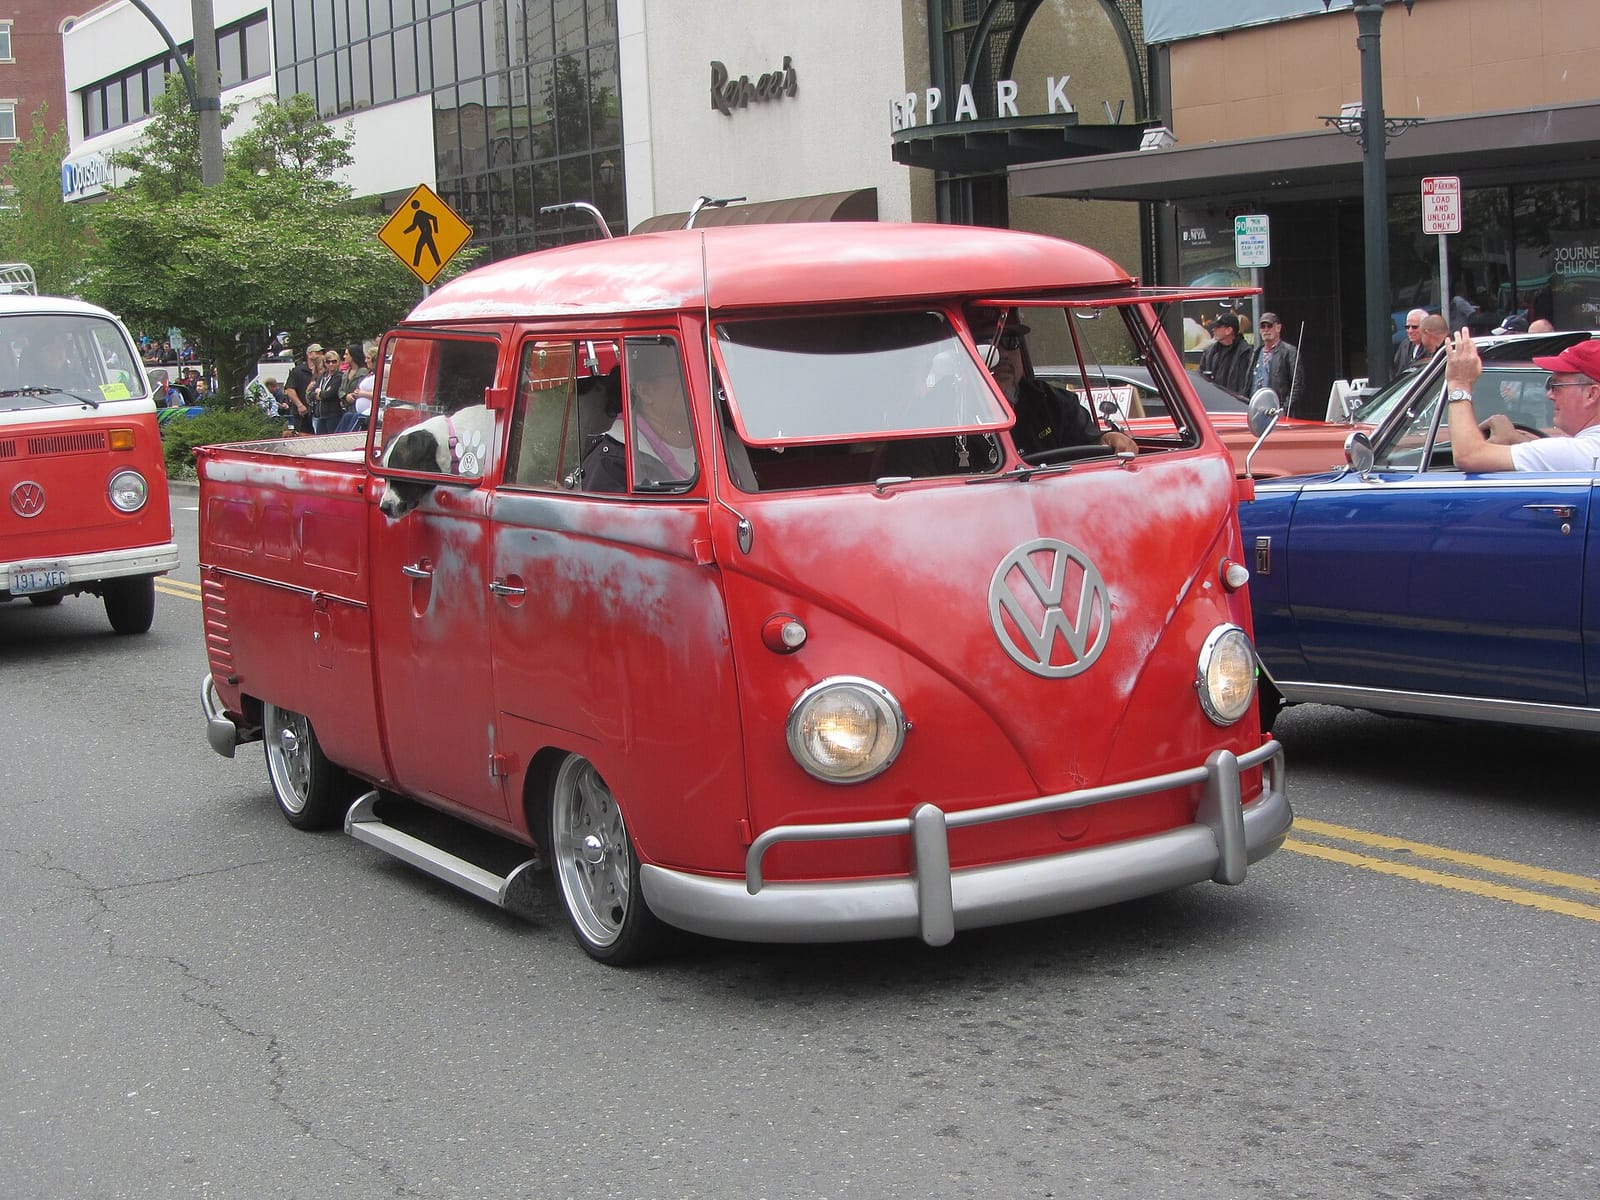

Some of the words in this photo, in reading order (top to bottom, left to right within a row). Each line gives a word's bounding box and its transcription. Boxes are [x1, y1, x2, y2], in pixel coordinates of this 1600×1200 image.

[710, 55, 797, 117] Renee's
[1424, 181, 1434, 193] NO
[1435, 182, 1457, 190] PARKING
[1431, 196, 1450, 204] LOAD
[1434, 204, 1449, 212] AND
[1427, 213, 1456, 222] UNLOAD
[1236, 221, 1246, 231] 90
[1432, 222, 1451, 231] ONLY
[1555, 260, 1600, 275] CHURCH
